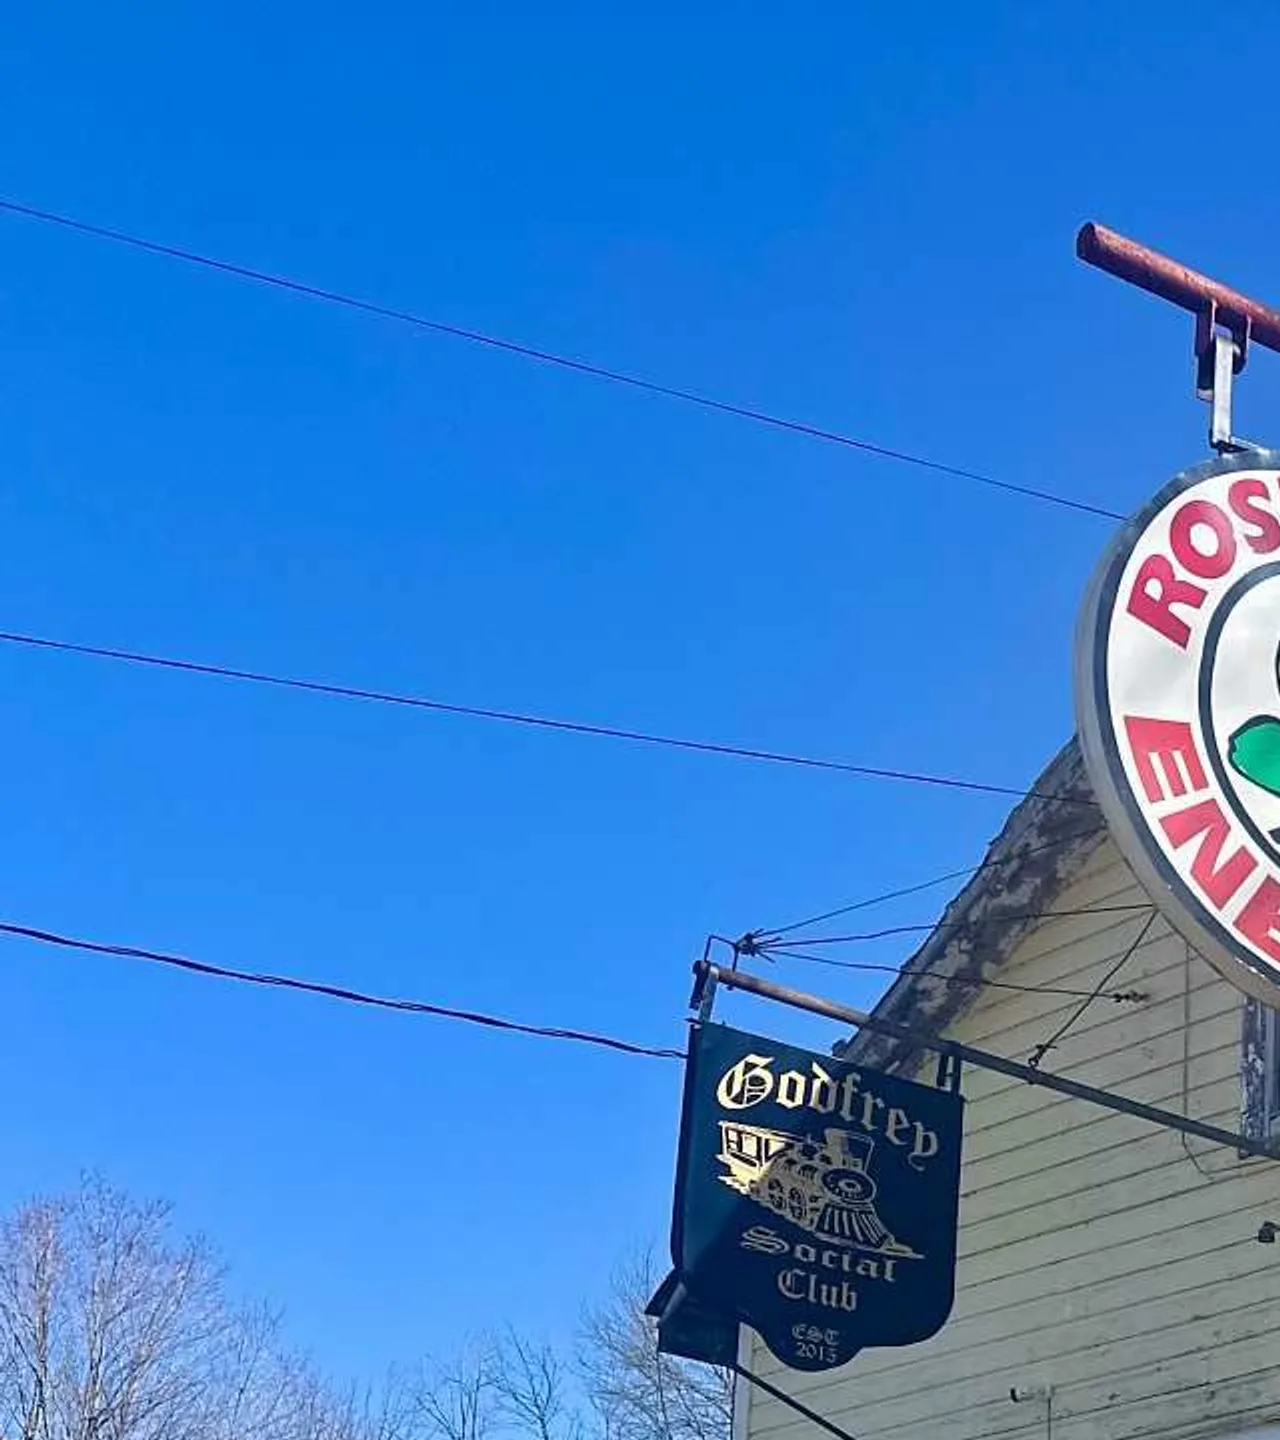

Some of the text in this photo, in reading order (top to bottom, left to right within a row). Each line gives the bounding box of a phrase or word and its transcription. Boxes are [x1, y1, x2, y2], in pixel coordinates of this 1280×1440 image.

[716, 1054, 939, 1172] Godfrey
[741, 1226, 897, 1282] Social
[777, 1269, 857, 1312] Club
